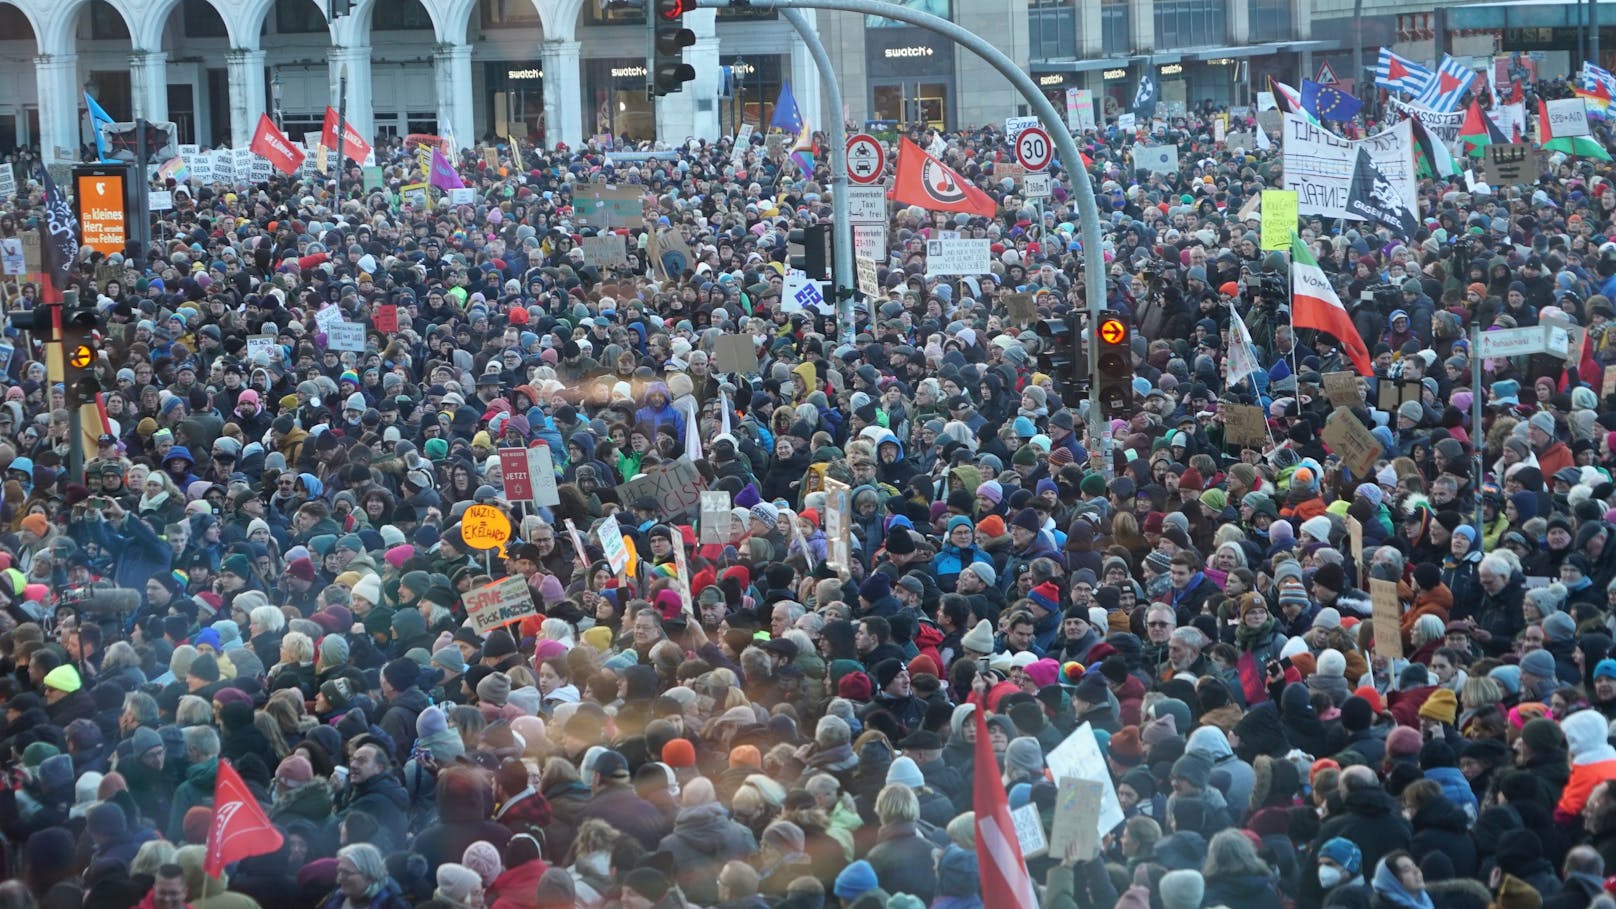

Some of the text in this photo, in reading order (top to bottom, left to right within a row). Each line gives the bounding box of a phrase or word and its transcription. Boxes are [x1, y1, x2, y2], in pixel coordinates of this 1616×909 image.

[885, 46, 926, 57] swatch
[508, 69, 540, 79] swatch
[611, 66, 642, 77] swatch
[1103, 70, 1122, 79] swatch
[1161, 66, 1179, 74] swatch
[1040, 75, 1060, 85] swatch
[1023, 139, 1044, 159] 30
[861, 200, 876, 209] Taxi
[92, 208, 123, 220] kleines
[869, 210, 882, 218] frei
[1353, 200, 1404, 231] GEGEN REC
[83, 220, 103, 232] Herz
[99, 233, 124, 244] Fehler.
[860, 249, 872, 257] frei
[505, 472, 527, 480] JETZT
[656, 475, 709, 518] CISM
[470, 507, 496, 519] NAZIS
[466, 590, 504, 613] SAVE
